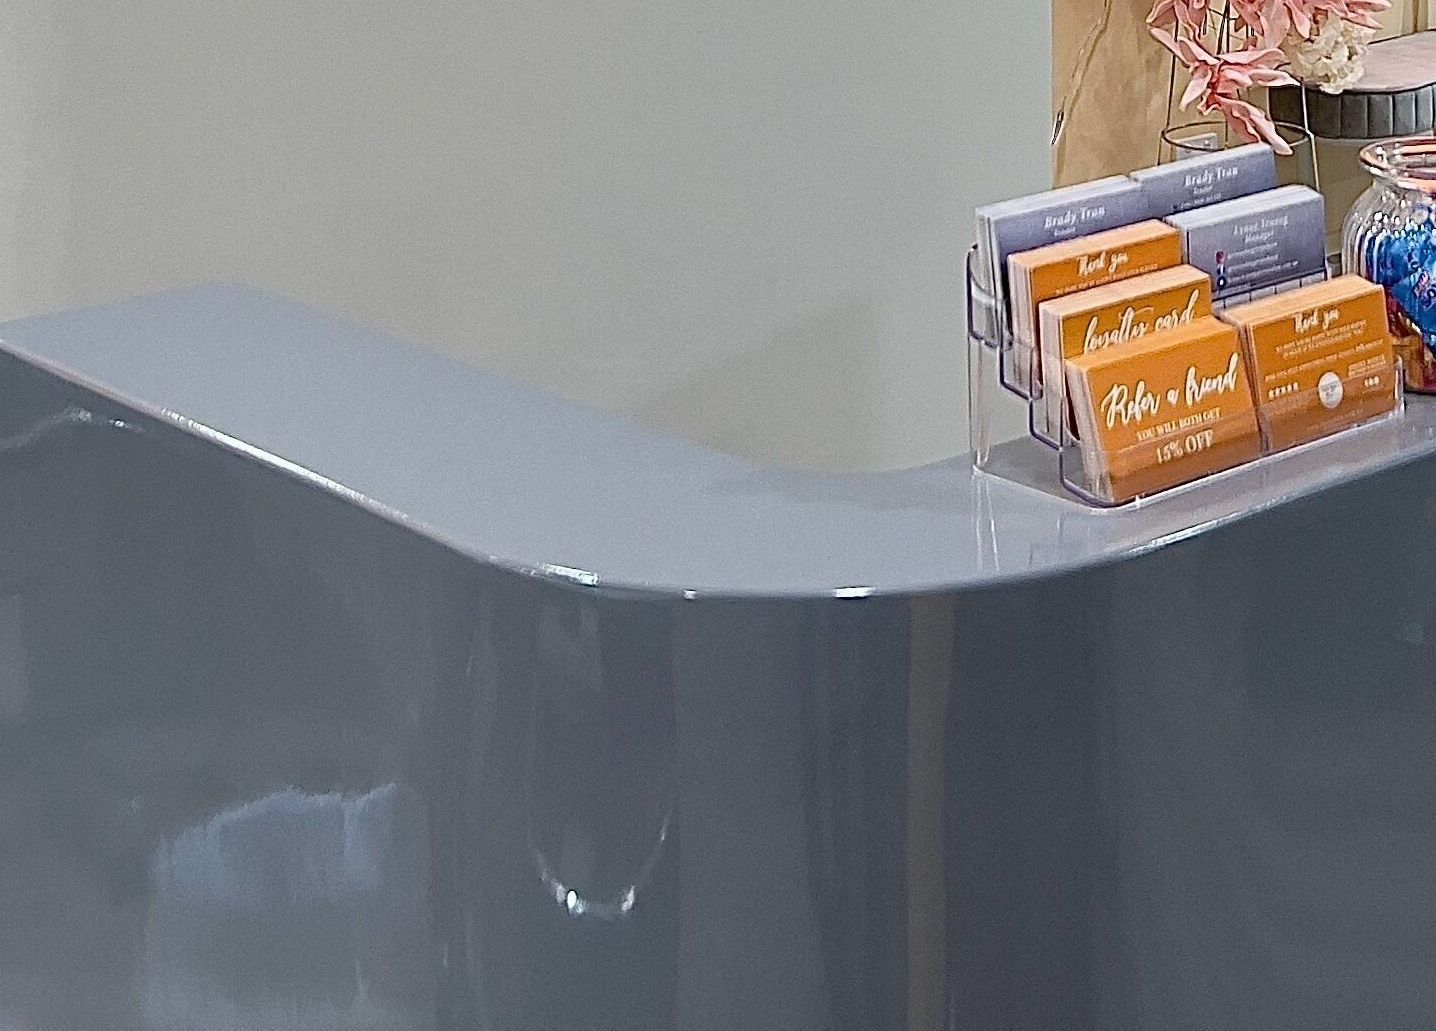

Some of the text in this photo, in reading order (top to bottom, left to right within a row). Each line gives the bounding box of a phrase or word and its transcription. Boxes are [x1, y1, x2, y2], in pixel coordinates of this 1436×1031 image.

[1184, 169, 1214, 186] Brady
[1044, 211, 1077, 229] Brady
[1155, 289, 1199, 331] card
[1100, 380, 1161, 430] Refer
[1166, 388, 1179, 405] a
[1185, 352, 1239, 407] friend
[1137, 407, 1221, 441] YOU WILL BOTH GET
[1156, 429, 1214, 464] 15% OFF
